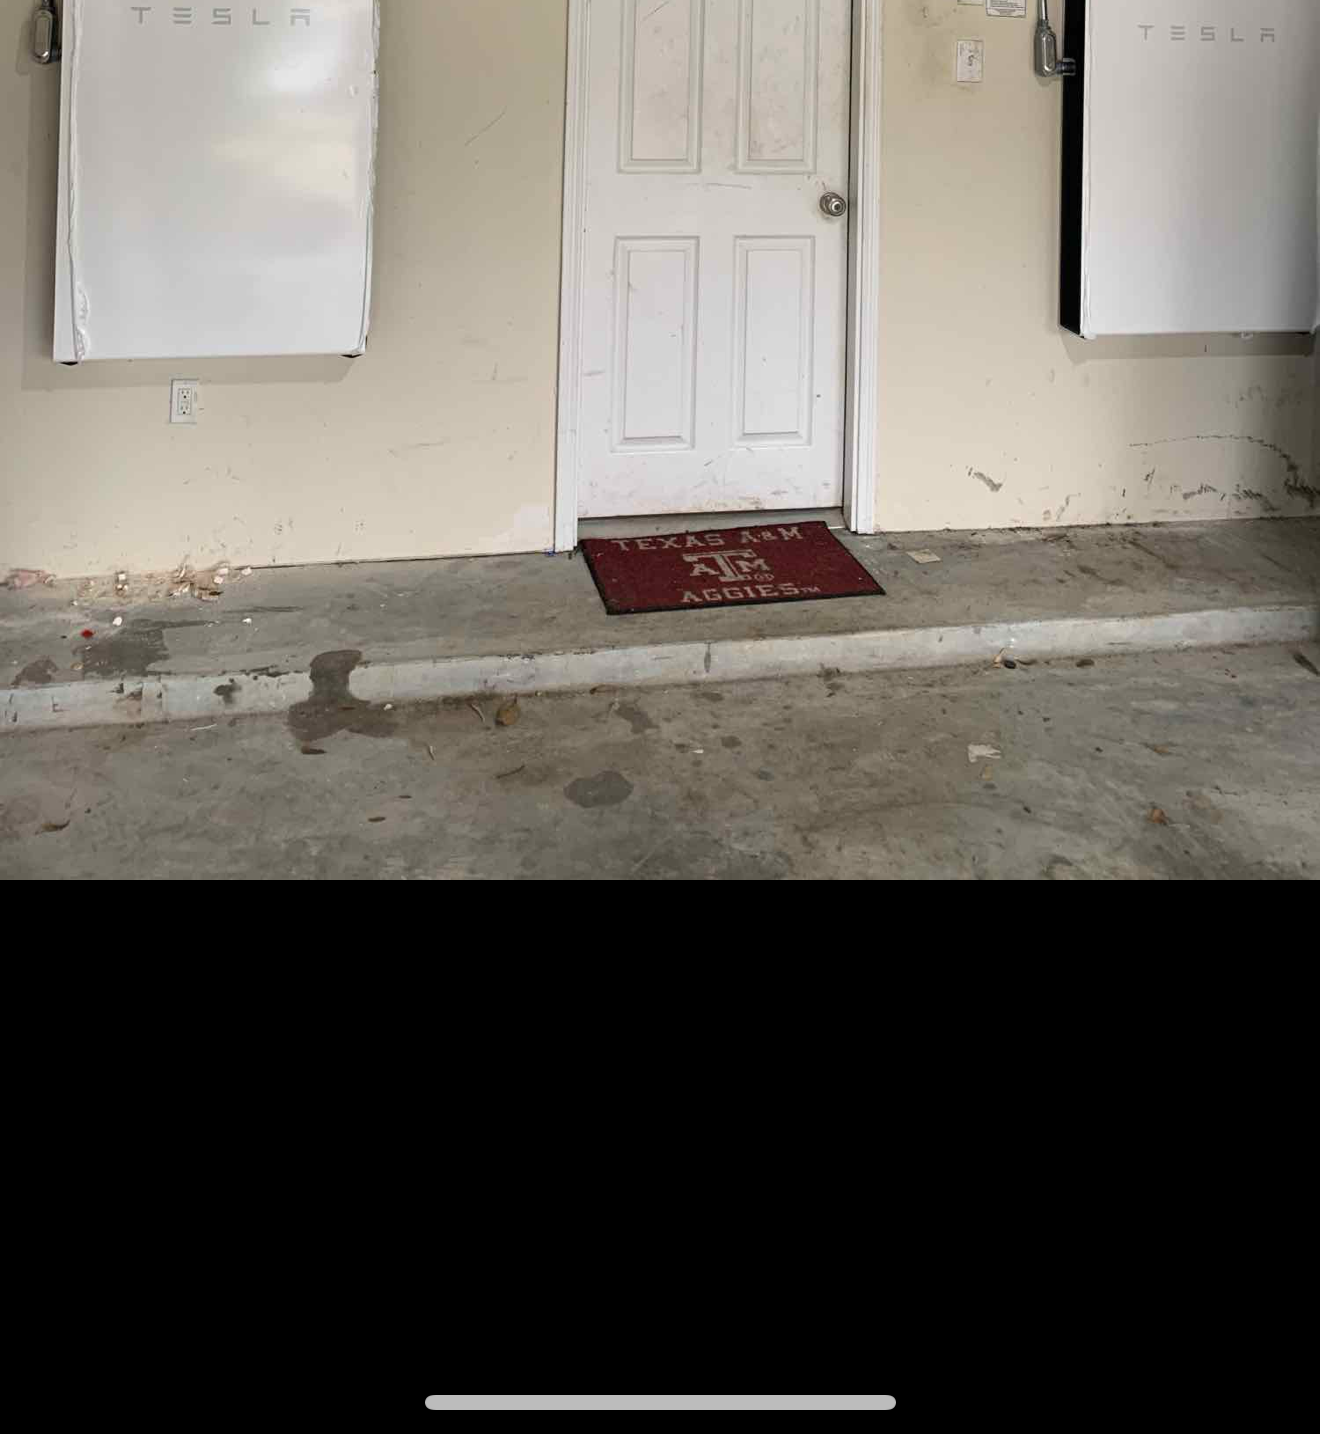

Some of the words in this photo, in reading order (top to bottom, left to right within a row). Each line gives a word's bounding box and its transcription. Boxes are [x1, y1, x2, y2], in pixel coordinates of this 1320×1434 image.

[130, 6, 311, 27] TESLA
[1137, 24, 1276, 43] TESLA
[611, 533, 726, 552] TEXAS
[740, 526, 804, 545] A&M
